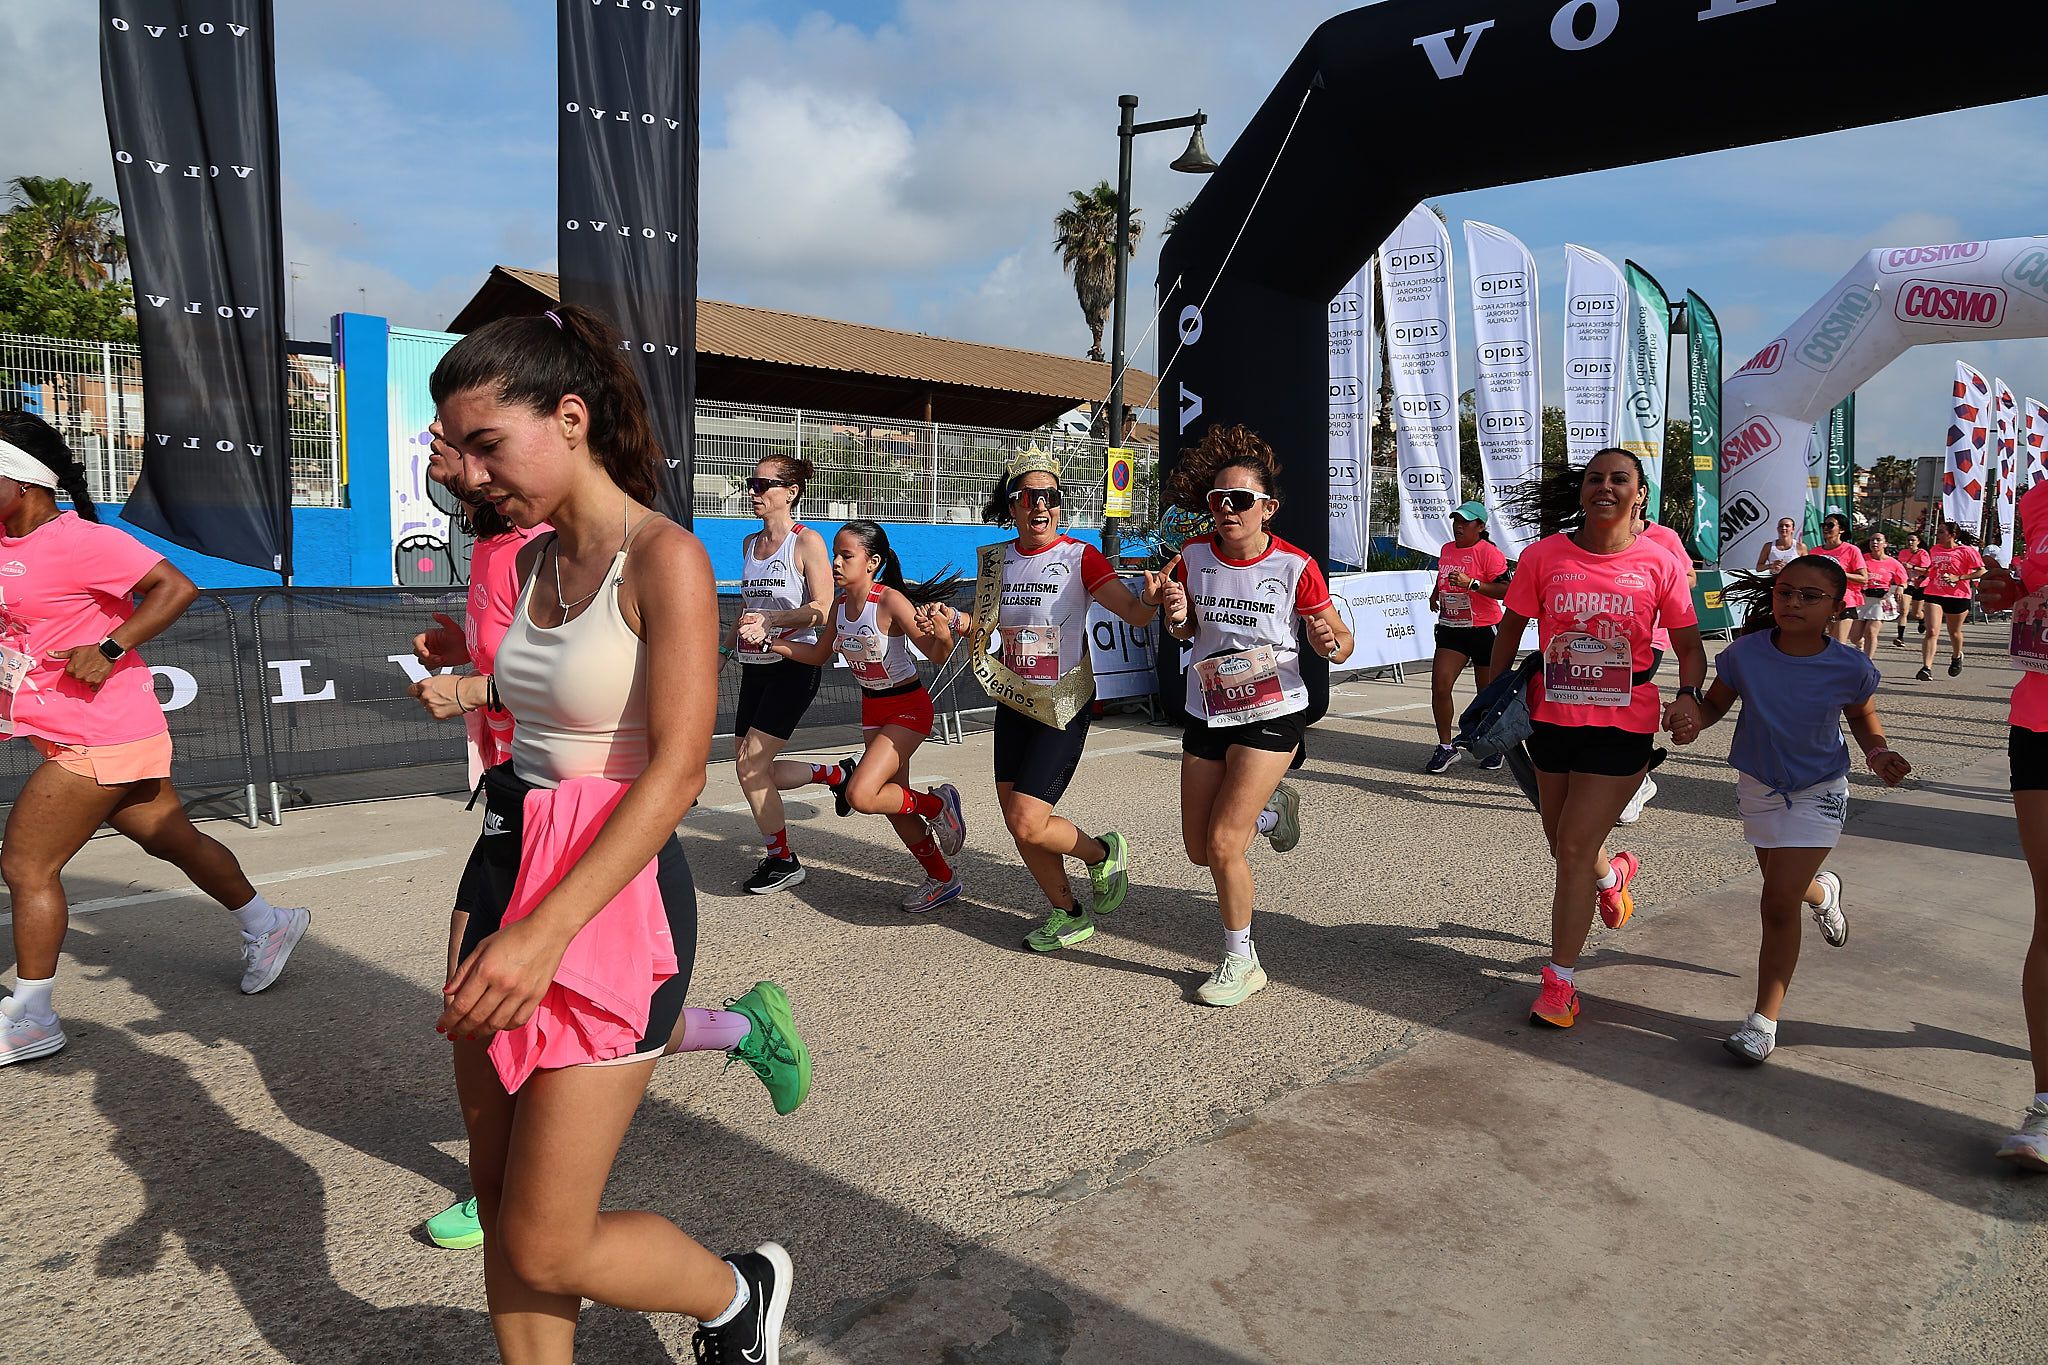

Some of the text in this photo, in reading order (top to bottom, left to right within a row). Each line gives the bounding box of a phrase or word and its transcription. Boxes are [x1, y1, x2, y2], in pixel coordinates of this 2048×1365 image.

[1888, 242, 1980, 268] COSMO
[1905, 286, 1998, 323] COSMO
[1803, 292, 1872, 365] COSMO
[750, 579, 786, 587] ATLETISME
[1552, 573, 1587, 584] OYSHO
[1012, 583, 1059, 594] ATLETISME
[1001, 595, 1042, 606] ALCÀSSER
[1194, 594, 1276, 614] CLUB ATLETISME
[1352, 594, 1386, 606] COSMÉTICA
[1386, 593, 1404, 603] FACIAL
[1554, 592, 1635, 615] CARRERA
[1382, 607, 1410, 617] Y CAPILAR
[1203, 610, 1258, 628] ALCÀSSER
[1386, 623, 1416, 639] ziaja.es
[1572, 642, 1605, 650] ASTURIANA
[1015, 655, 1037, 667] 016
[1570, 665, 1604, 678] 016
[1226, 683, 1257, 700] 016
[1216, 716, 1242, 724] OYSHO
